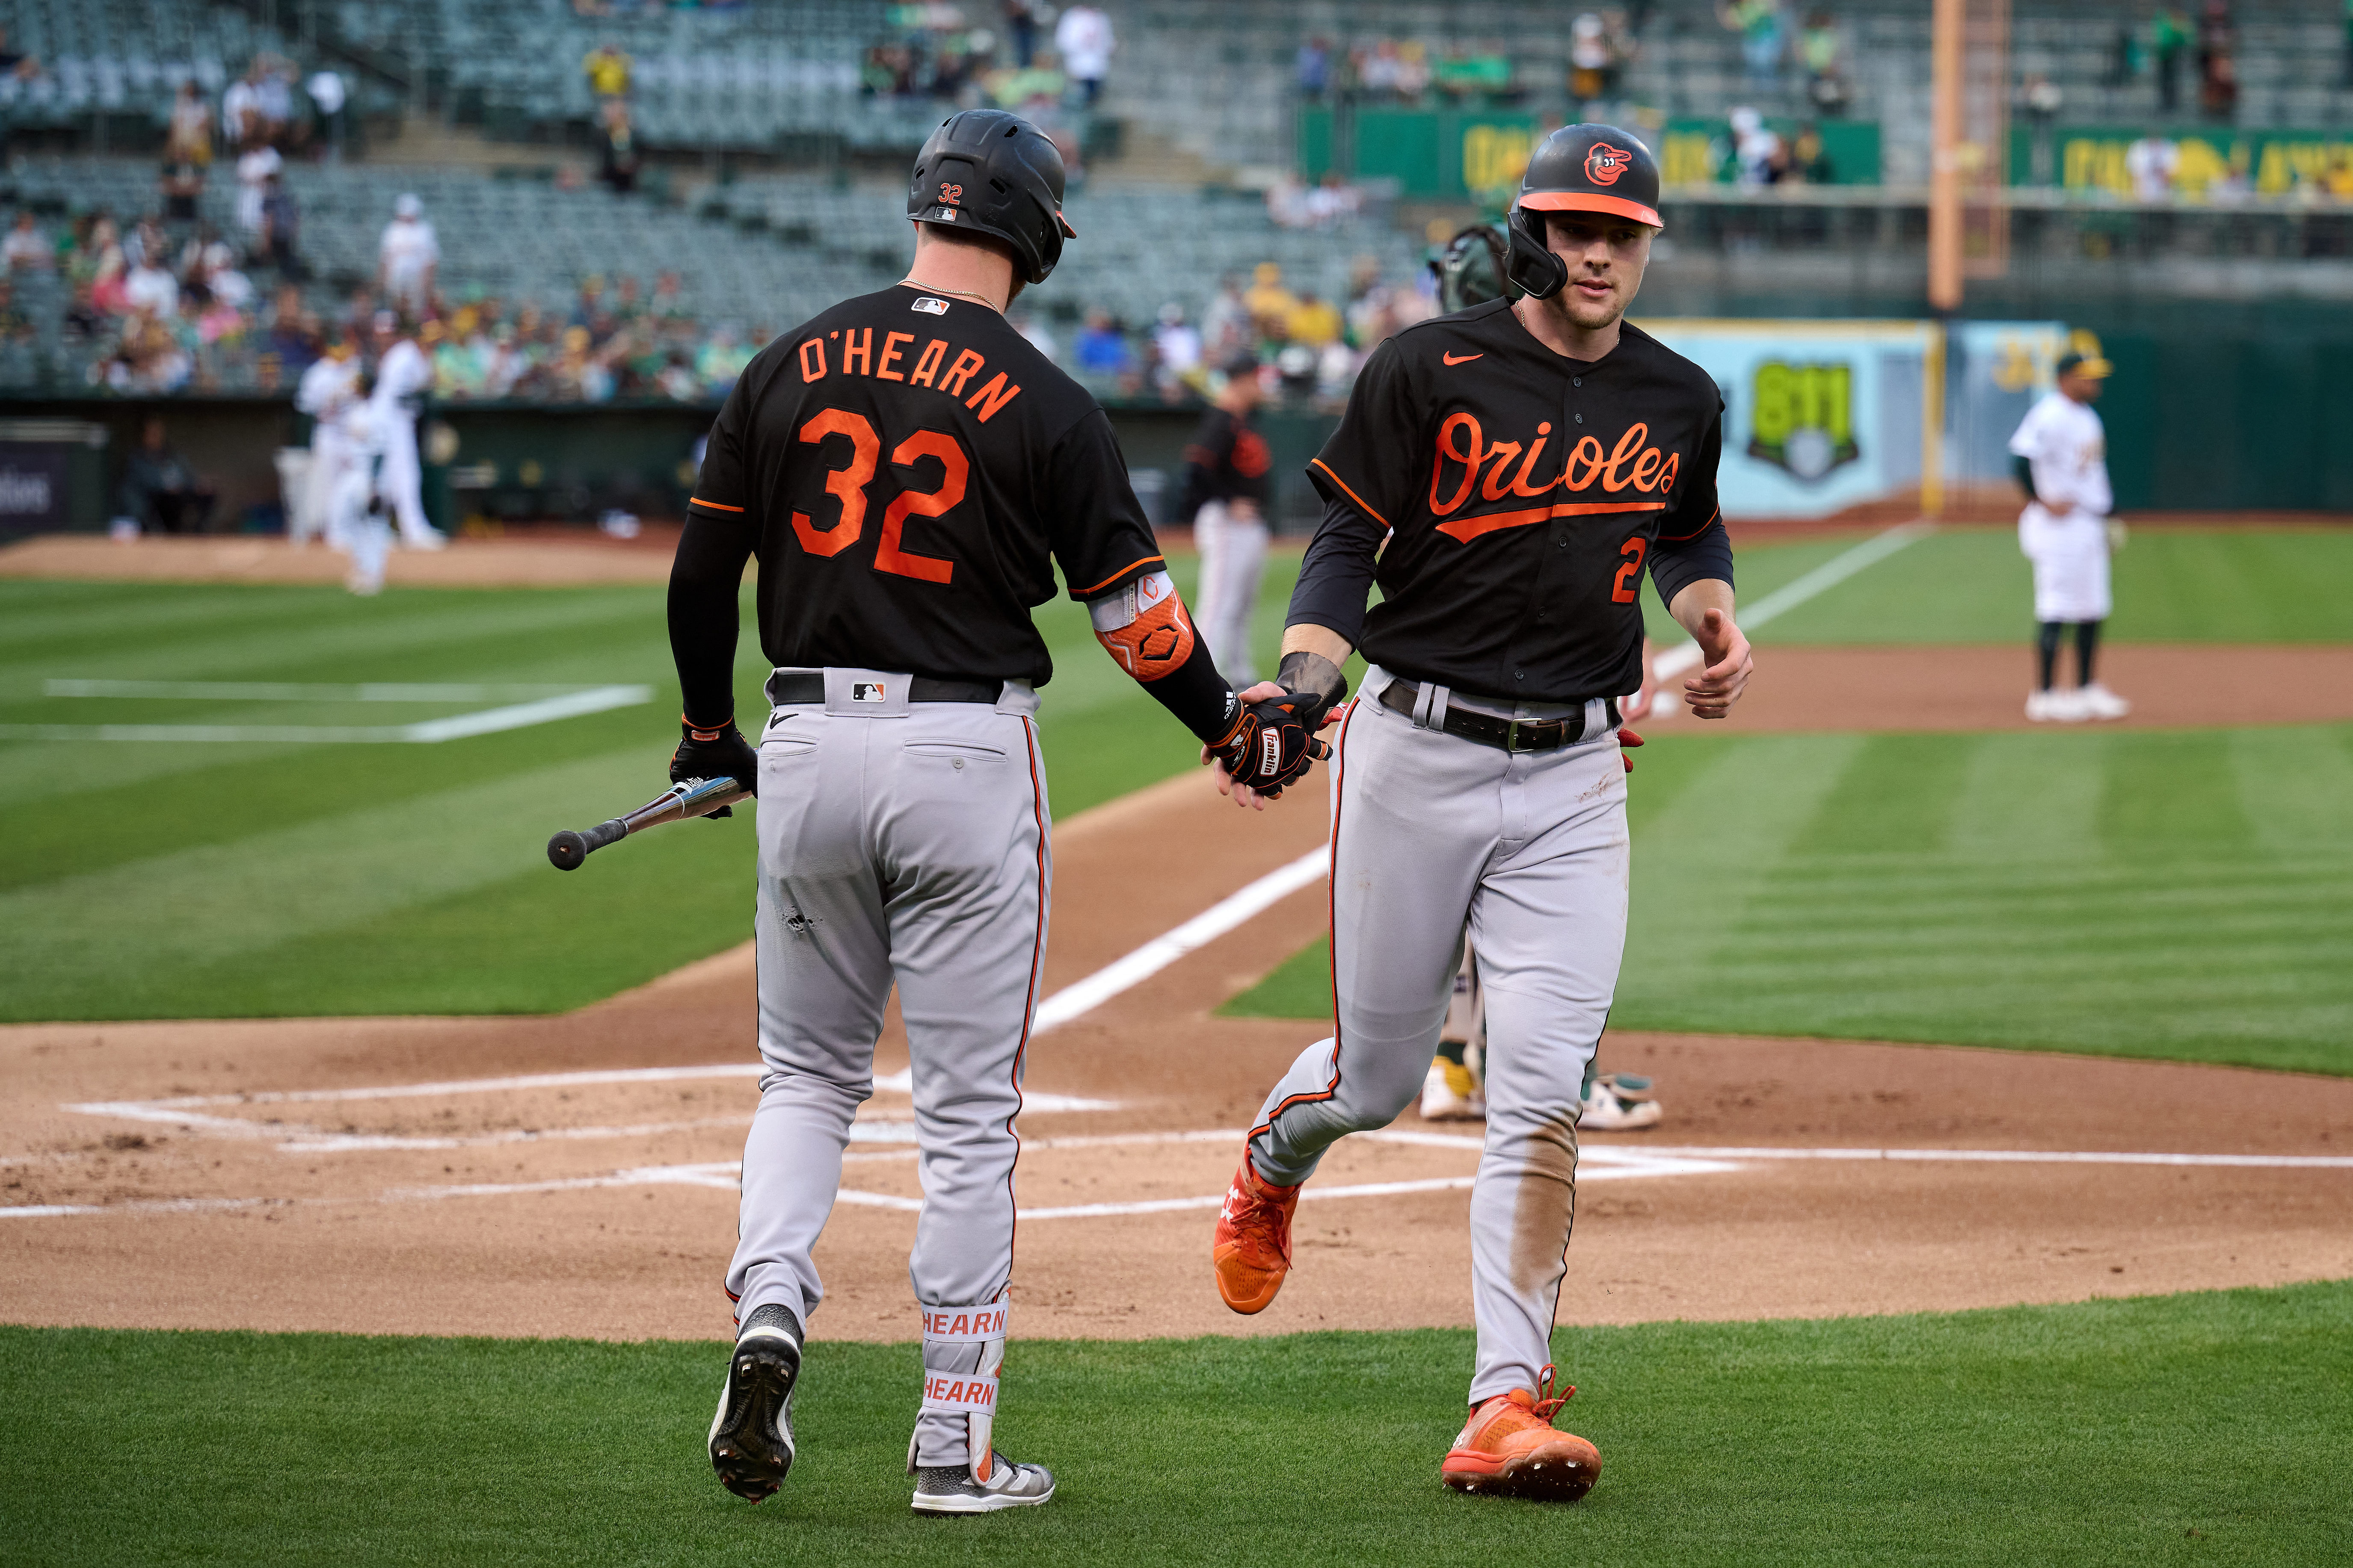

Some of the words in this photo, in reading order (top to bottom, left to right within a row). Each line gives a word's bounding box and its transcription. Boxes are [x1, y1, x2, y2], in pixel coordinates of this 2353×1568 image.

[938, 183, 962, 205] 32
[799, 328, 1022, 423] O'HEARN
[1429, 412, 1680, 516] Orioles
[791, 408, 969, 584] 32
[1612, 537, 1646, 604] 2
[1263, 732, 1278, 773] Franklin
[922, 1309, 1005, 1335] HEARN
[924, 1376, 995, 1405] HEARN
